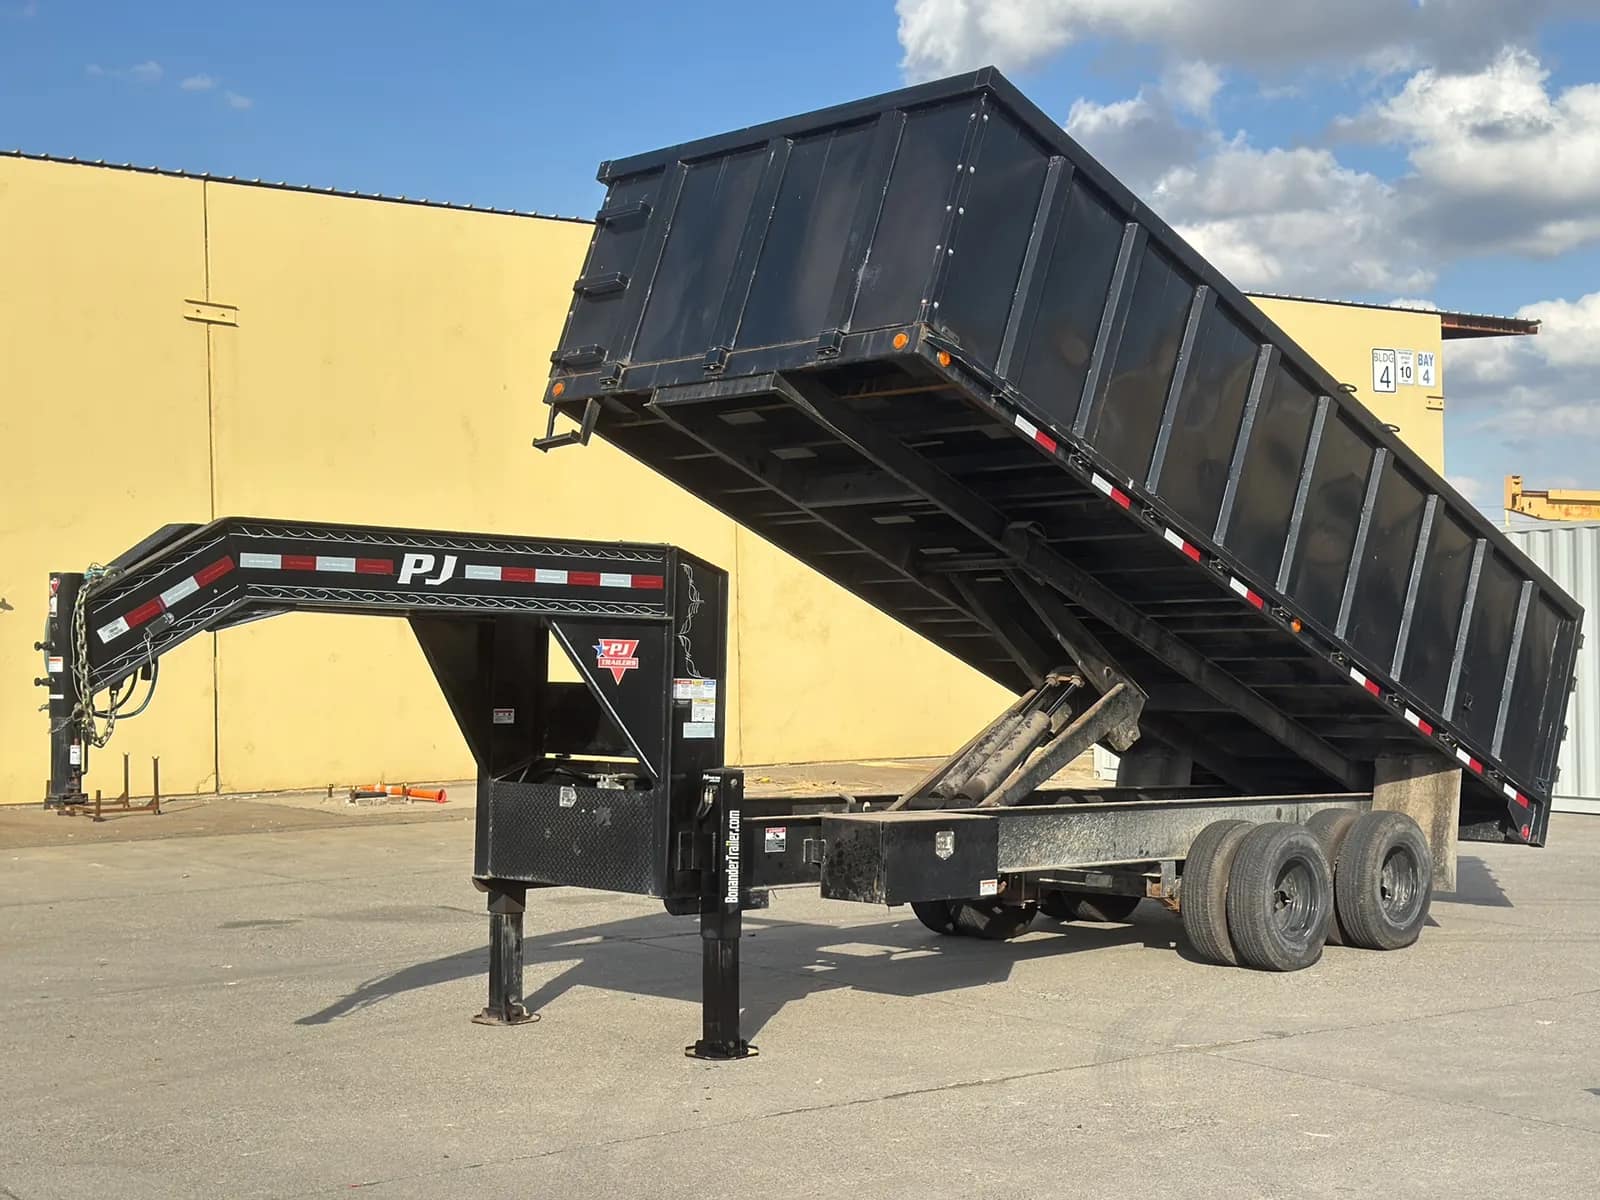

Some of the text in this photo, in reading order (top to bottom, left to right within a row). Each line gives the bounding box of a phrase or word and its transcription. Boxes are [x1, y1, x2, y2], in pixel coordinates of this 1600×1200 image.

[1373, 352, 1394, 363] BLDG
[1418, 353, 1434, 367] BAY
[1380, 366, 1391, 389] 4
[1400, 366, 1412, 379] 10
[1423, 369, 1431, 384] 4
[397, 553, 458, 585] PJ
[609, 643, 630, 655] PJ
[724, 809, 740, 904] BonanderTrailer.com
